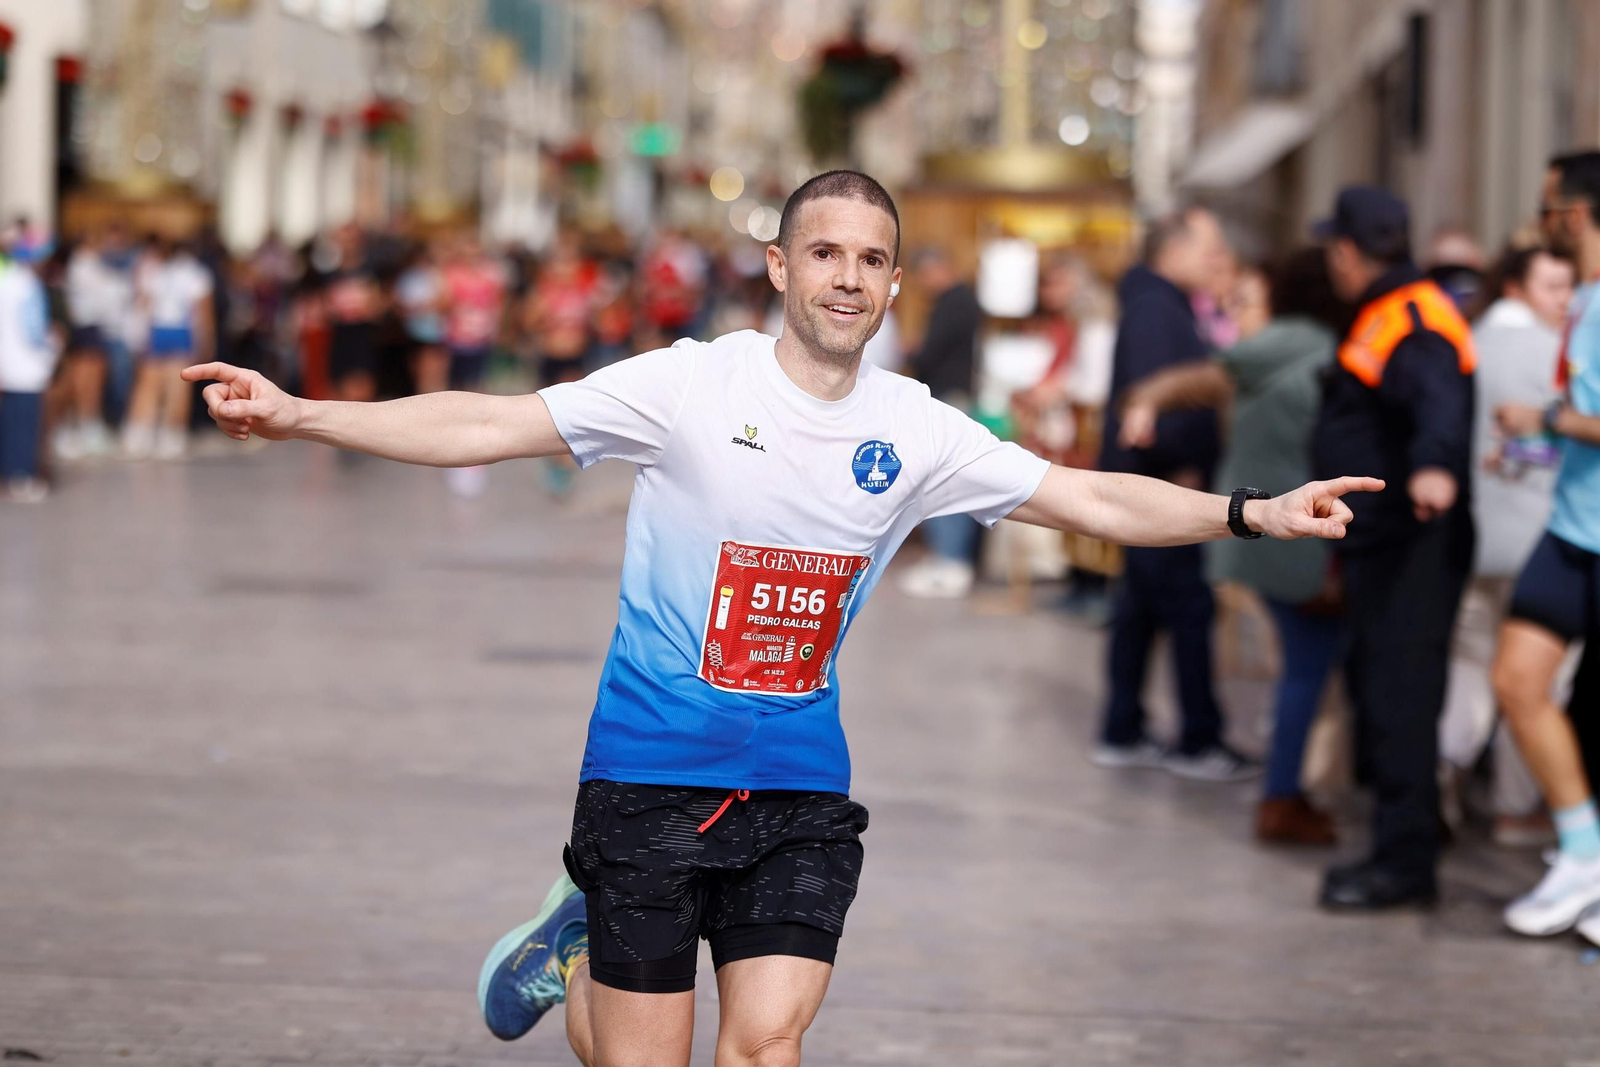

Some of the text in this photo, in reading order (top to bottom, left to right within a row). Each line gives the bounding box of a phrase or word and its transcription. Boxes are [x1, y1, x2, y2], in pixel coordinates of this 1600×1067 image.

[731, 437, 766, 452] SPALL
[856, 443, 874, 461] Somos
[762, 550, 853, 576] GENERALI
[750, 583, 826, 615] 5156
[747, 614, 821, 630] PEDRO GALEAS
[752, 634, 785, 643] GENERALI
[749, 648, 782, 662] MÁLAGA
